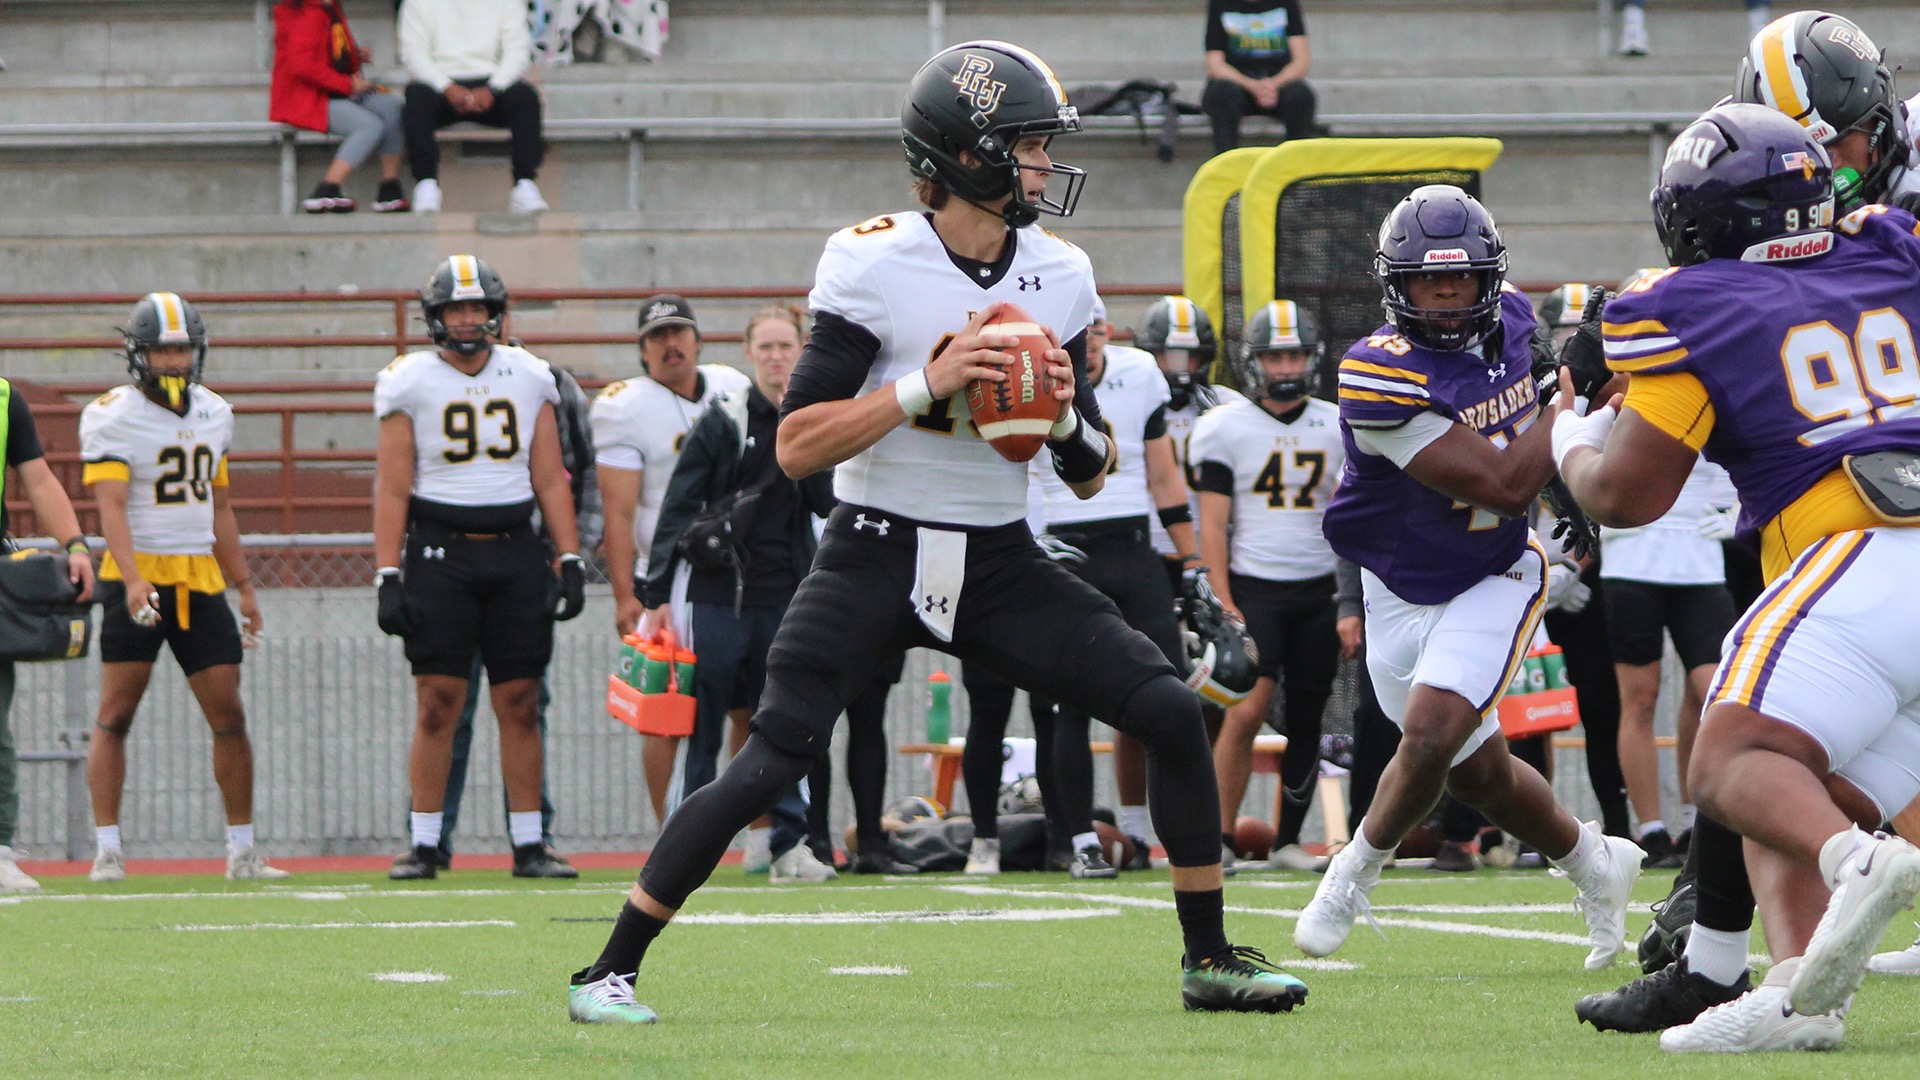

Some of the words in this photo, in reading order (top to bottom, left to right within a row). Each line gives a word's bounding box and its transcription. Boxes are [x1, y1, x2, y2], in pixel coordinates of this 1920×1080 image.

[952, 53, 1007, 116] PLU
[1429, 251, 1464, 262] Riddell
[1766, 235, 1830, 260] Riddell
[1020, 350, 1035, 404] Wilson
[1780, 305, 1920, 447] 99
[441, 397, 522, 465] 93
[154, 442, 214, 507] 20
[1252, 449, 1328, 511] 47
